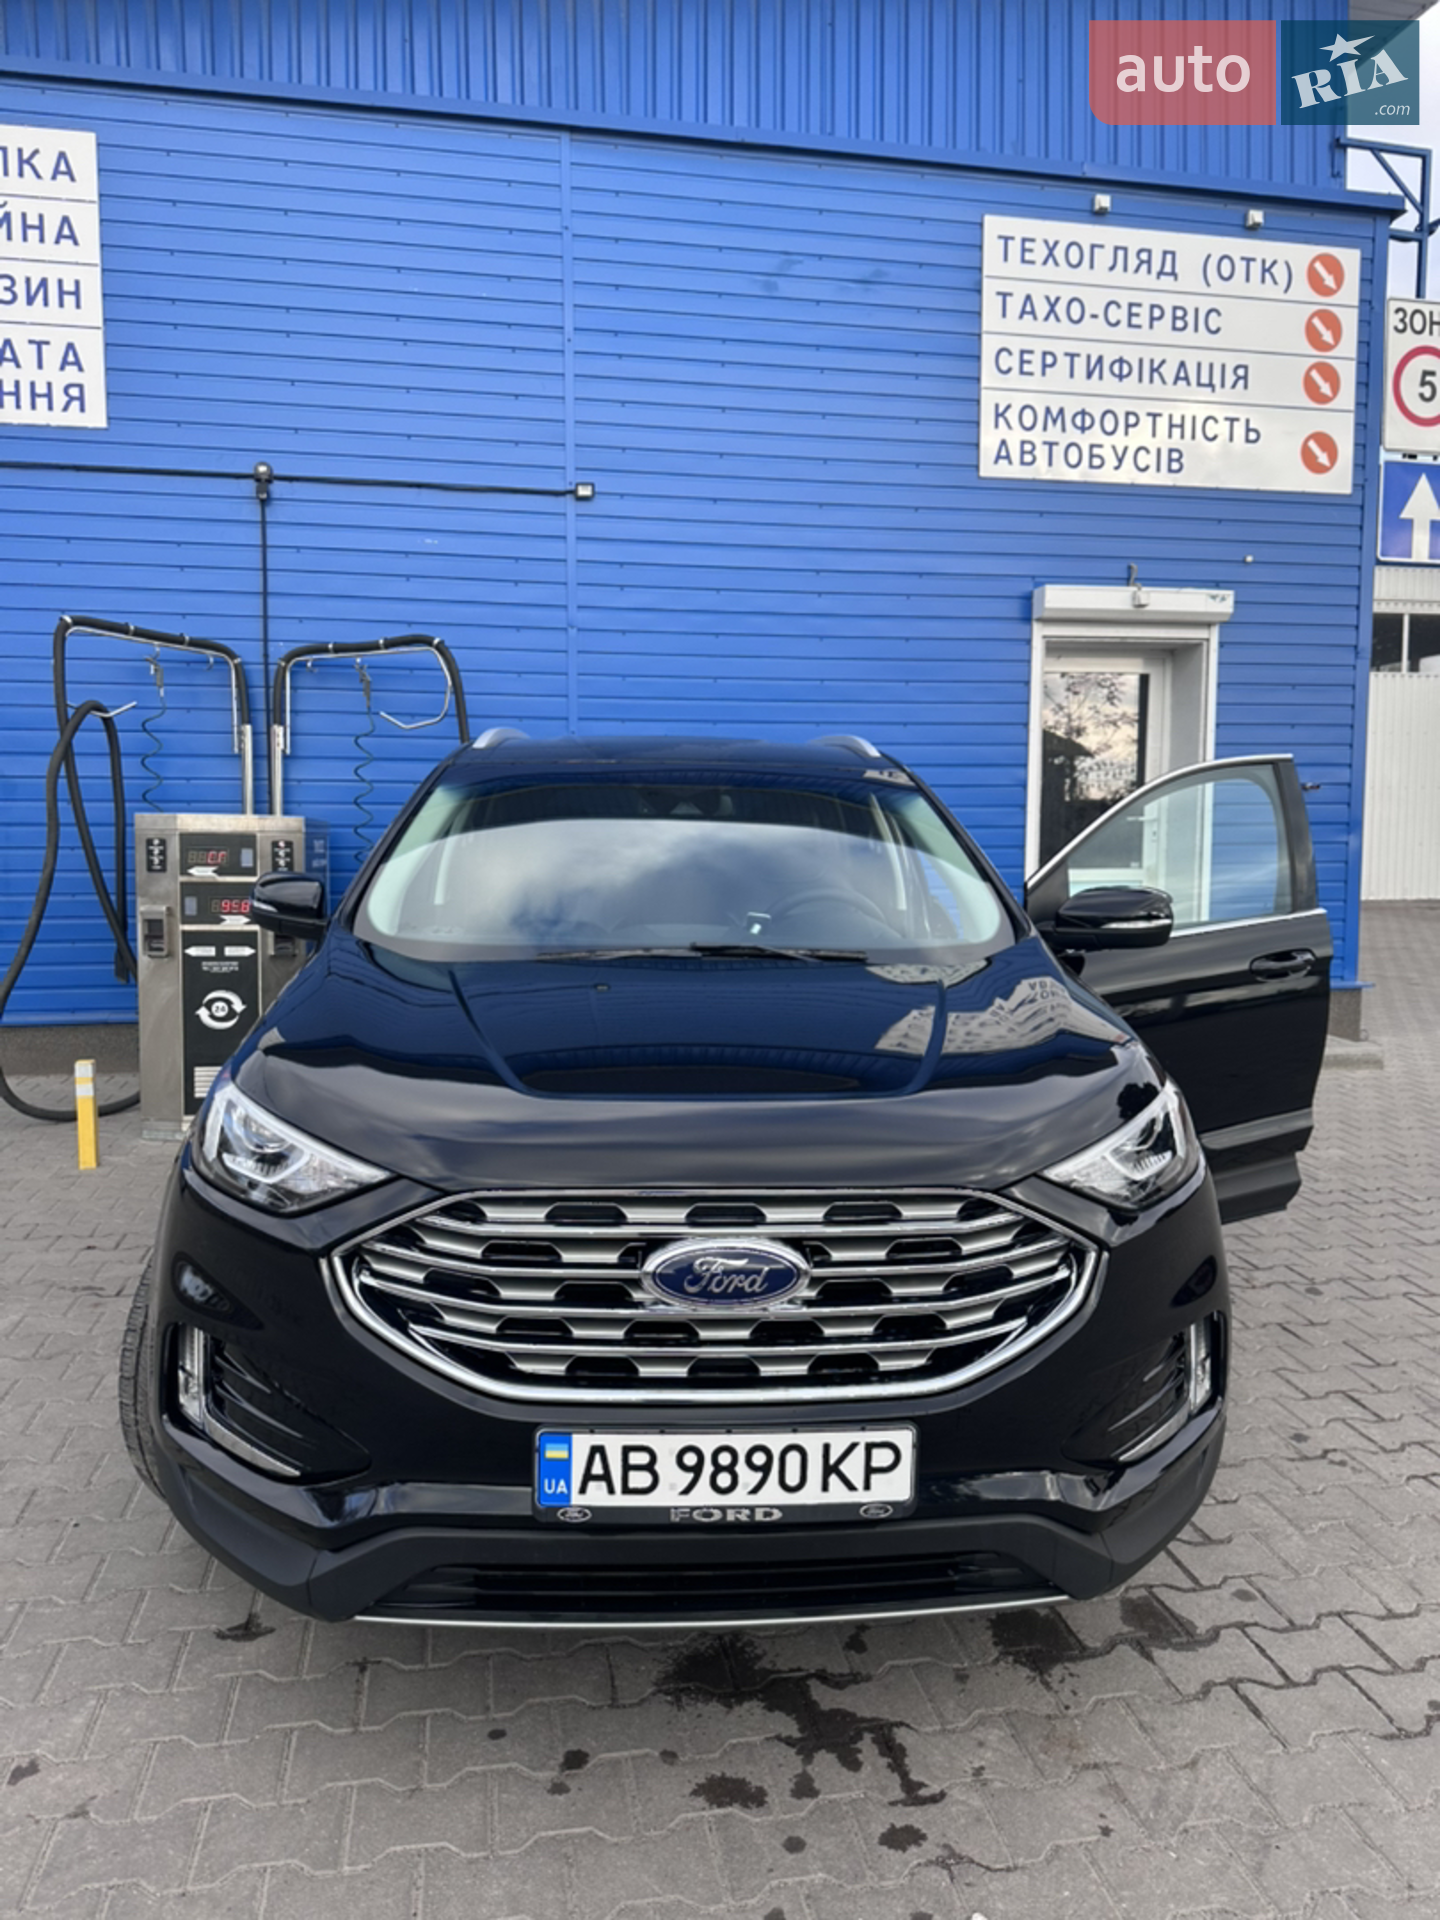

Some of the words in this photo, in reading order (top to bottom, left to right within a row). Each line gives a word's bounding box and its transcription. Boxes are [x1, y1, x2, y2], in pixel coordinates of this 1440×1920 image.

[997, 235, 1179, 281] ТЕХОГЛЯД
[1202, 253, 1293, 294] (ОТК)
[0, 274, 82, 310] ЗИН
[995, 291, 1223, 335] ТАХО-СЕРВІС
[994, 347, 1249, 393] СЕРТИФІКАЦІЯ
[993, 403, 1262, 444] КОМФОРТНІСТЬ
[993, 439, 1185, 474] АВТОБУСІВ
[684, 1257, 770, 1293] Ford
[544, 1478, 568, 1494] UA
[578, 1444, 659, 1495] AB
[675, 1443, 808, 1495] 9890
[820, 1441, 902, 1492] KP
[669, 1507, 783, 1522] FORD
